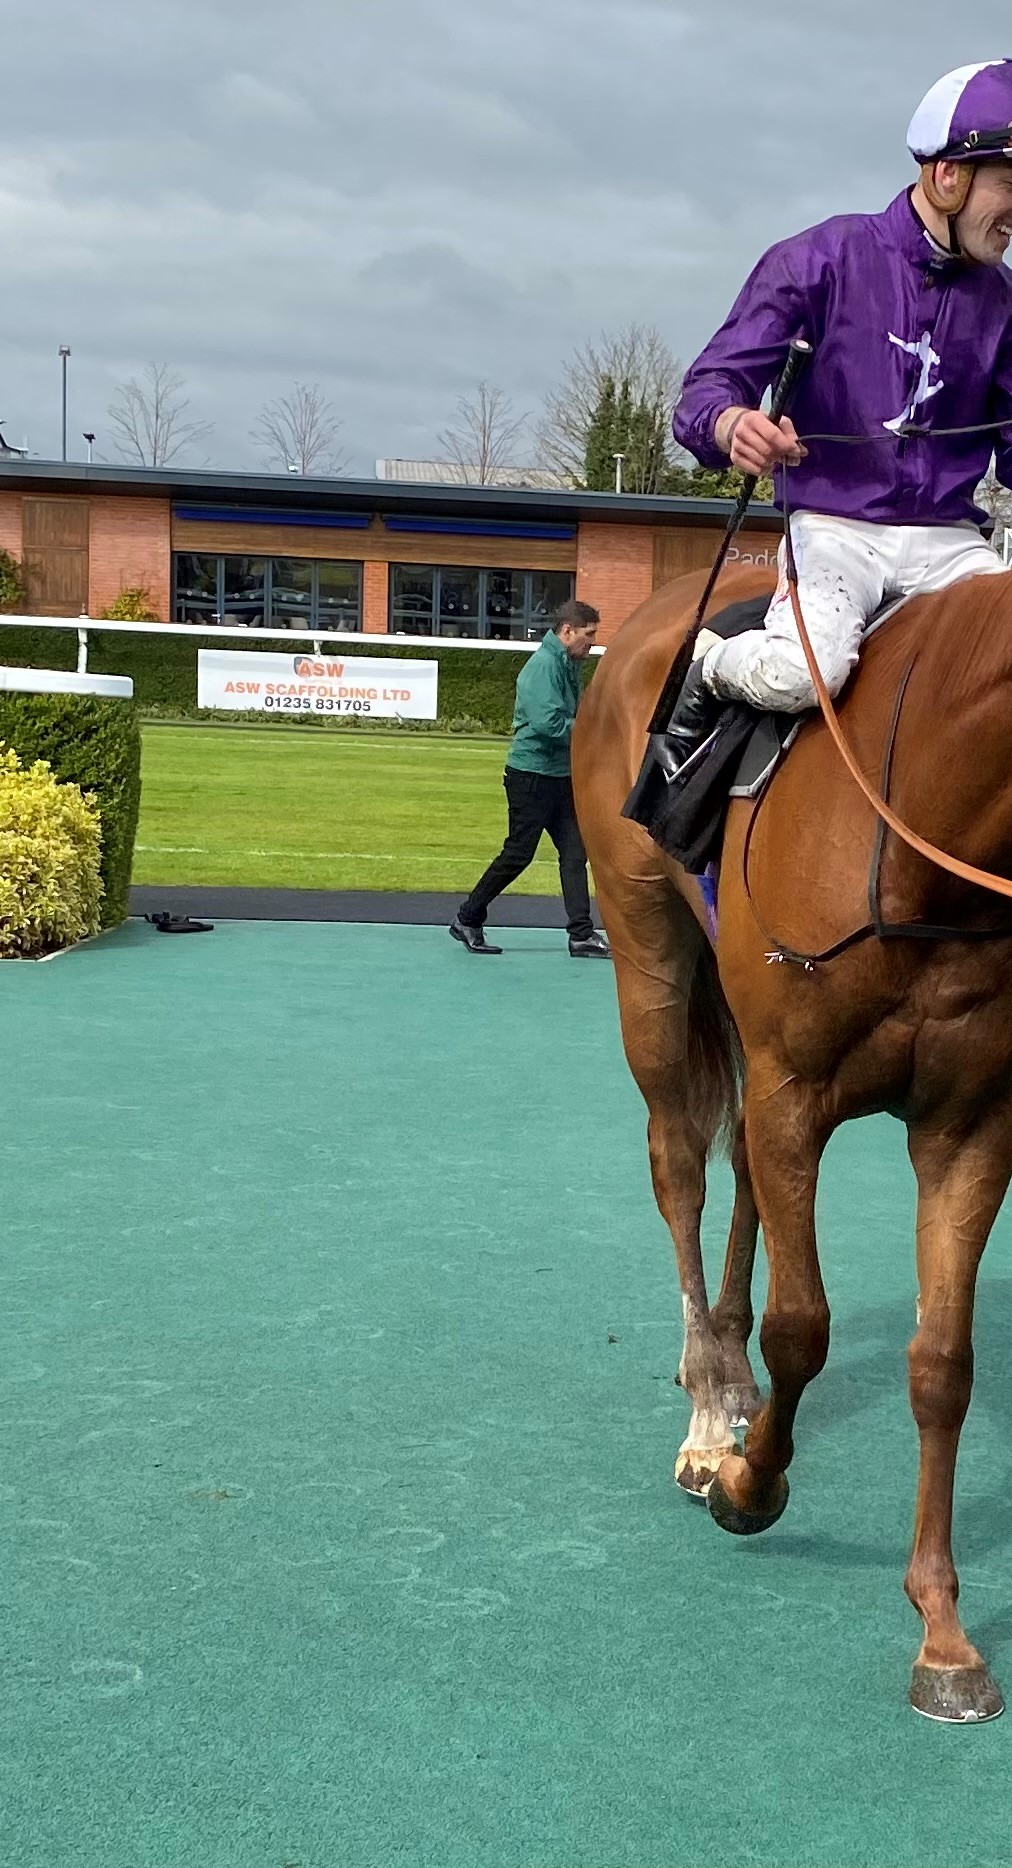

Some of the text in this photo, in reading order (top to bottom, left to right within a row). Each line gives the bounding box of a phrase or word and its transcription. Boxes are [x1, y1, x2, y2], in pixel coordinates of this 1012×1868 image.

[299, 661, 345, 678] ASW
[224, 681, 411, 701] ASW SCAFFOLDING LTD
[264, 696, 371, 712] 01235 831705
